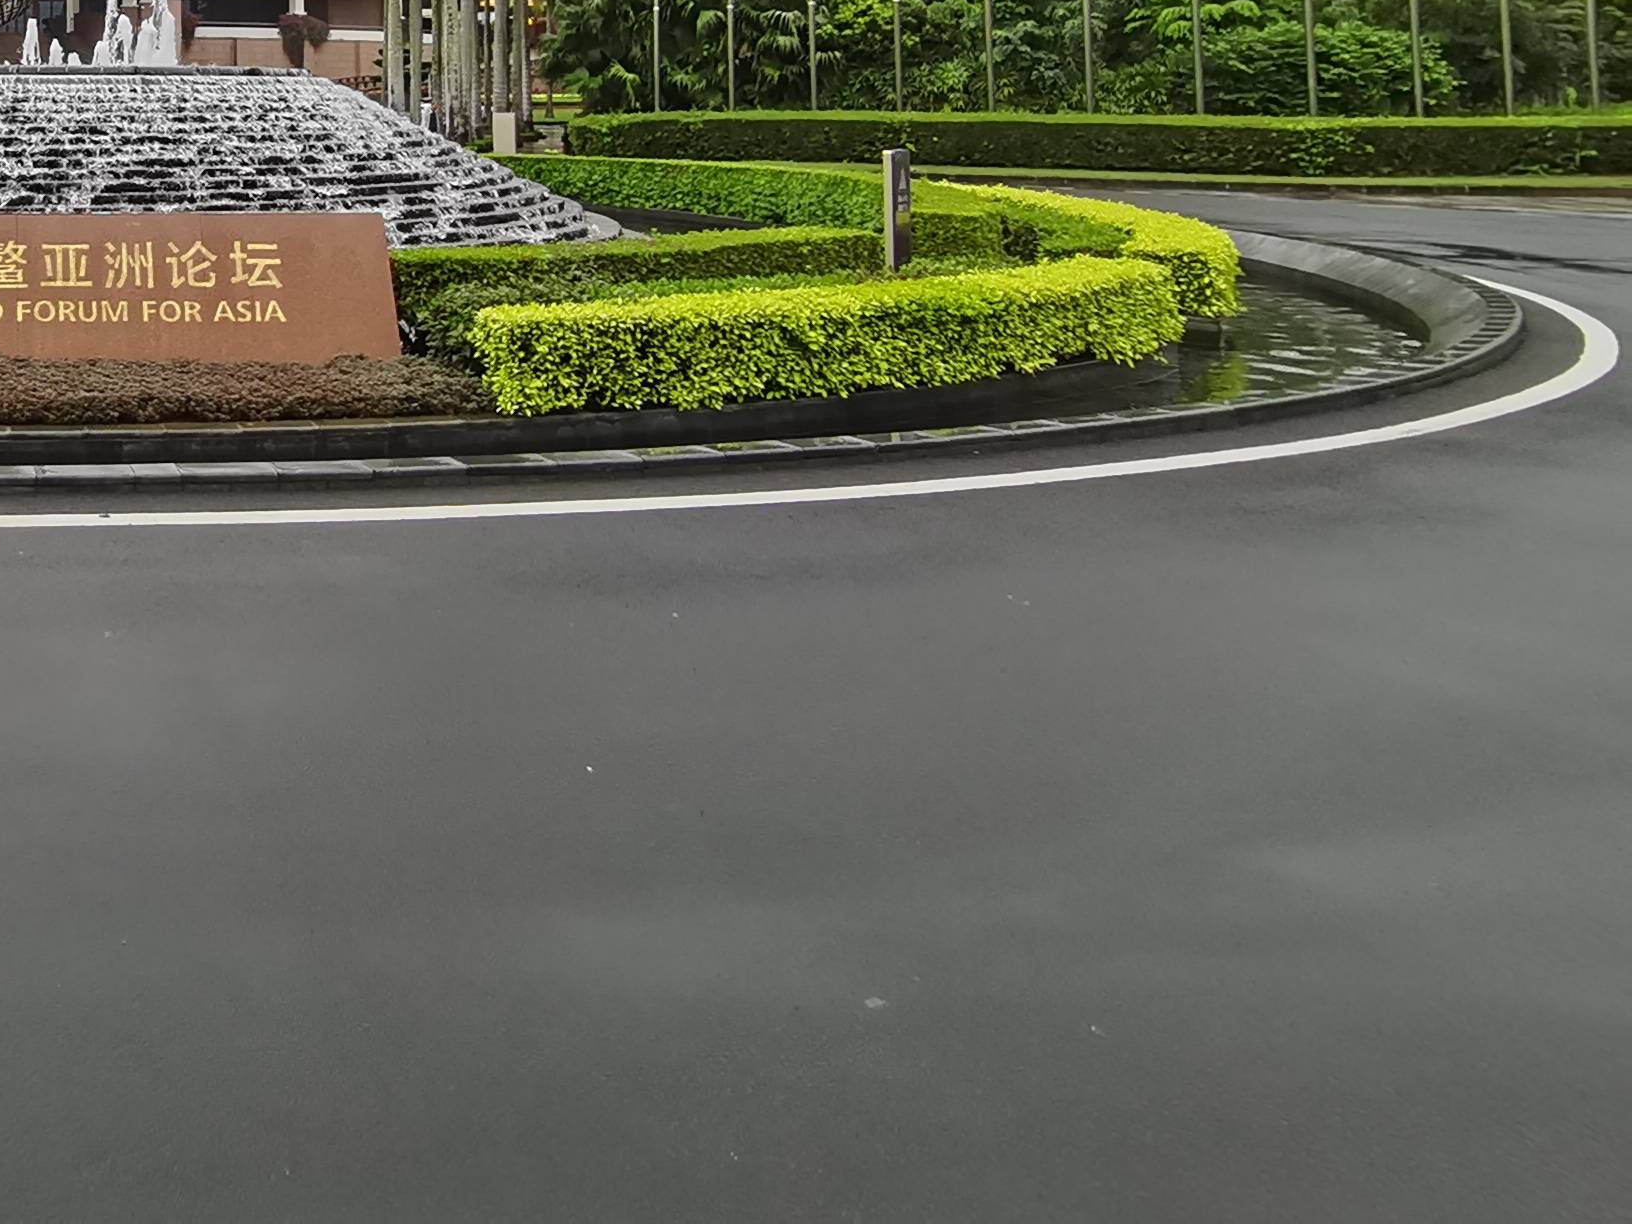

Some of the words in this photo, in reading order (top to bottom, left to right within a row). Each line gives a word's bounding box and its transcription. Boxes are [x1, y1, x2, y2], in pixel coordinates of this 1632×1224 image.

[16, 300, 129, 323] FORUM
[142, 300, 203, 323] FOR
[213, 300, 287, 323] ASIA
